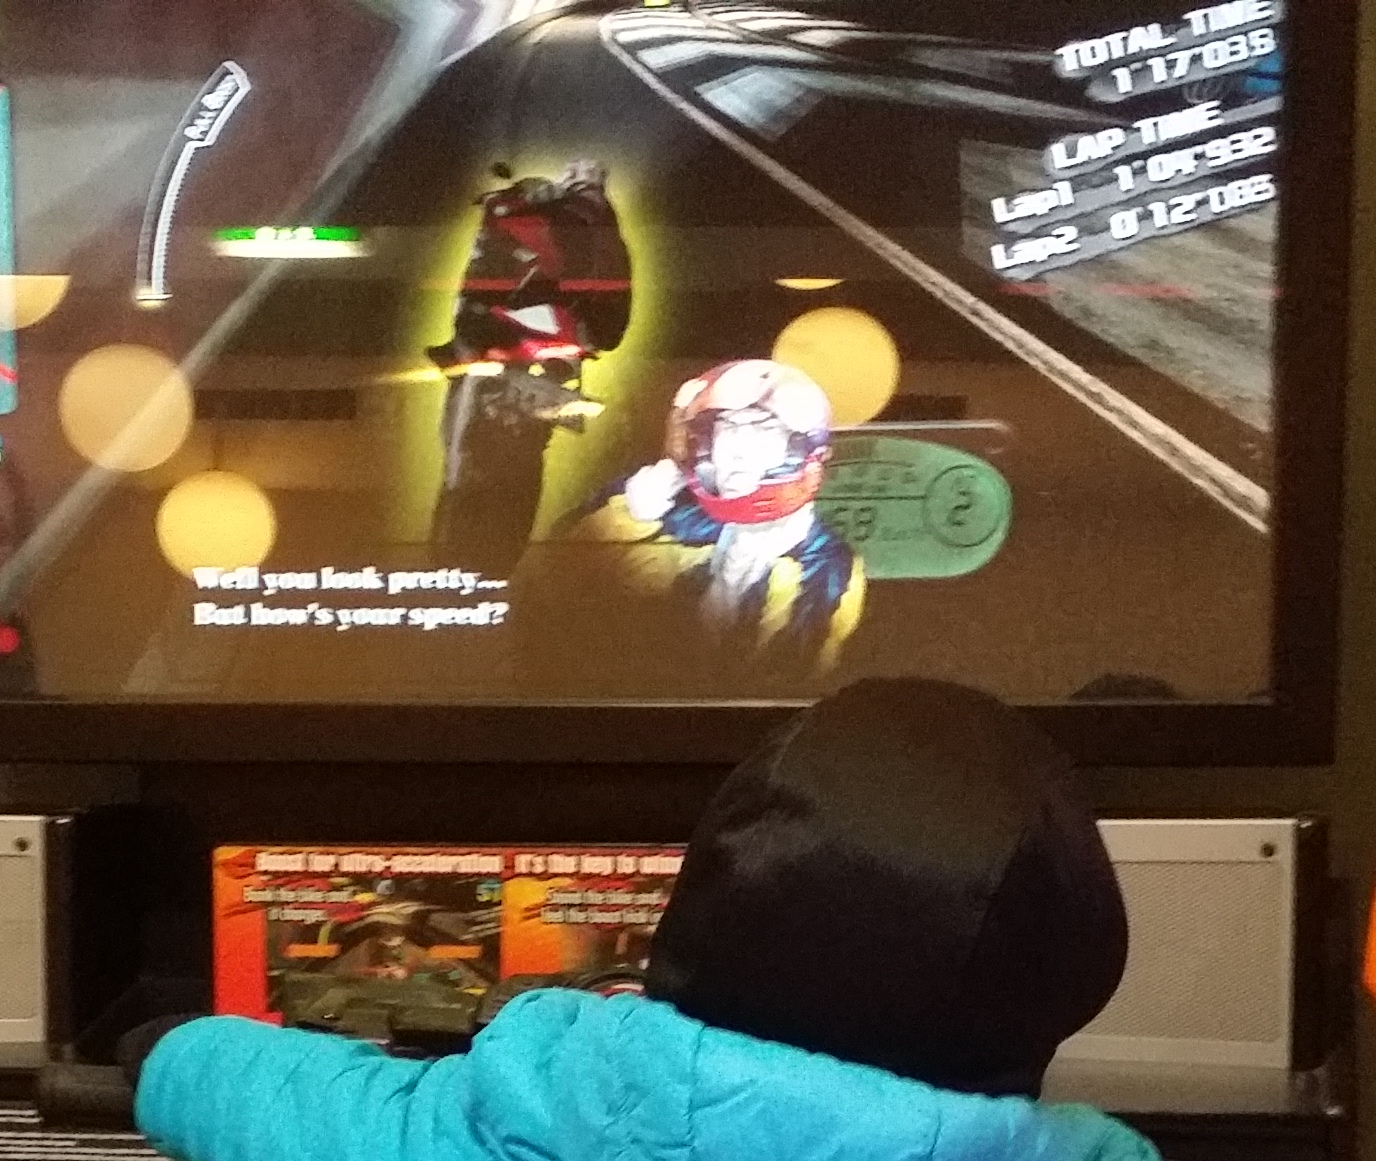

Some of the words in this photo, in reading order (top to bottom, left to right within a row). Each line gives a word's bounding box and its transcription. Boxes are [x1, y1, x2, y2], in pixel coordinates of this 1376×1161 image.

[1055, 23, 1177, 71] TOTAL
[1182, 0, 1276, 37] TIME
[1050, 127, 1125, 169] LAP
[1133, 101, 1224, 144] TIME
[192, 567, 259, 589] Well
[262, 572, 317, 595] you
[321, 566, 384, 589] look
[193, 602, 246, 625] But
[249, 602, 334, 625] how's
[336, 607, 407, 631] your
[408, 601, 510, 630] speed?
